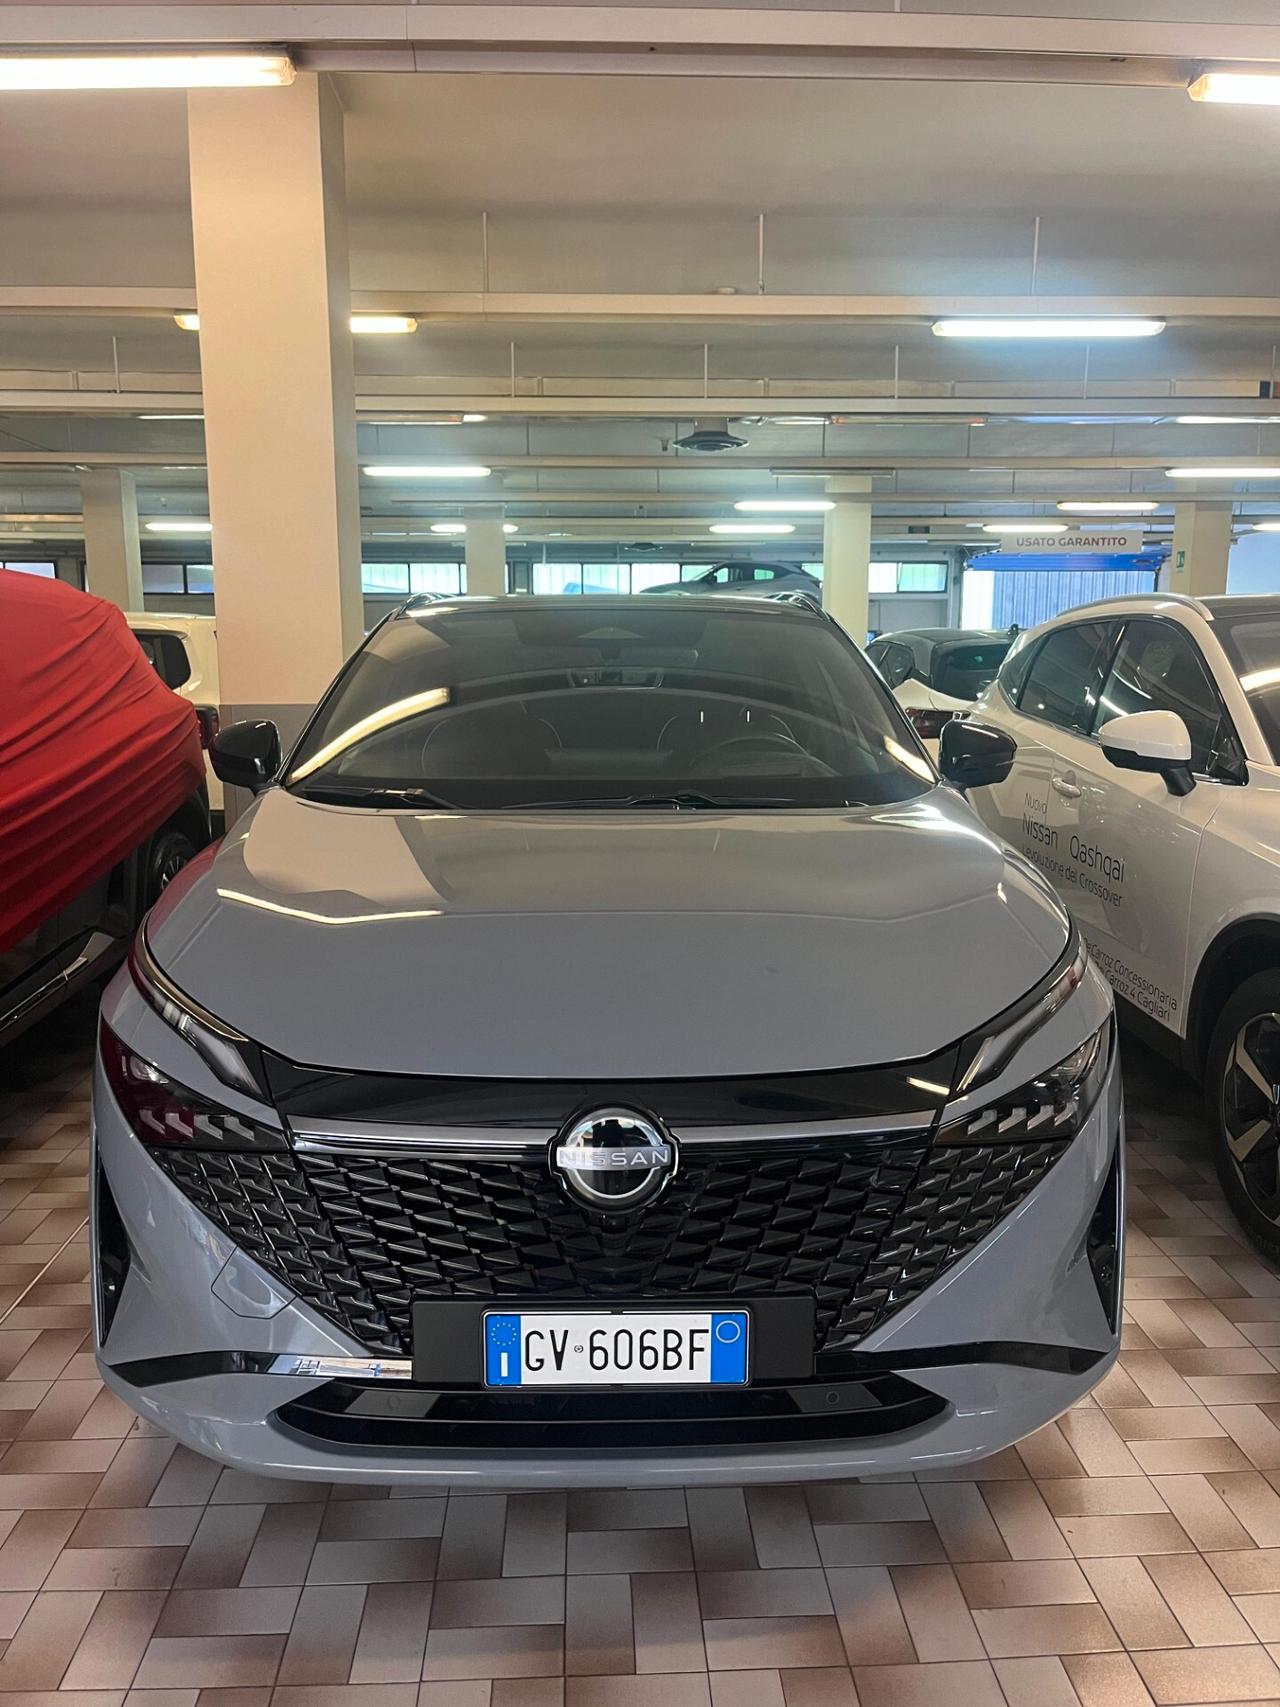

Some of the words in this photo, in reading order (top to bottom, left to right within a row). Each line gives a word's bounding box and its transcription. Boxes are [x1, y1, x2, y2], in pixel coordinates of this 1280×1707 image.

[1016, 537, 1055, 547] USATO
[1058, 536, 1127, 547] GARANTITO
[1022, 812, 1058, 849] Nissan
[1070, 835, 1125, 883] Qashqai
[1080, 872, 1122, 907] Crossover
[1114, 960, 1177, 1011] Concessionaria
[1130, 988, 1136, 1000] 4
[1137, 991, 1170, 1021] Cagliari
[560, 1150, 668, 1166] NISSAN
[524, 1330, 569, 1371] GV
[589, 1329, 710, 1371] 606BF
